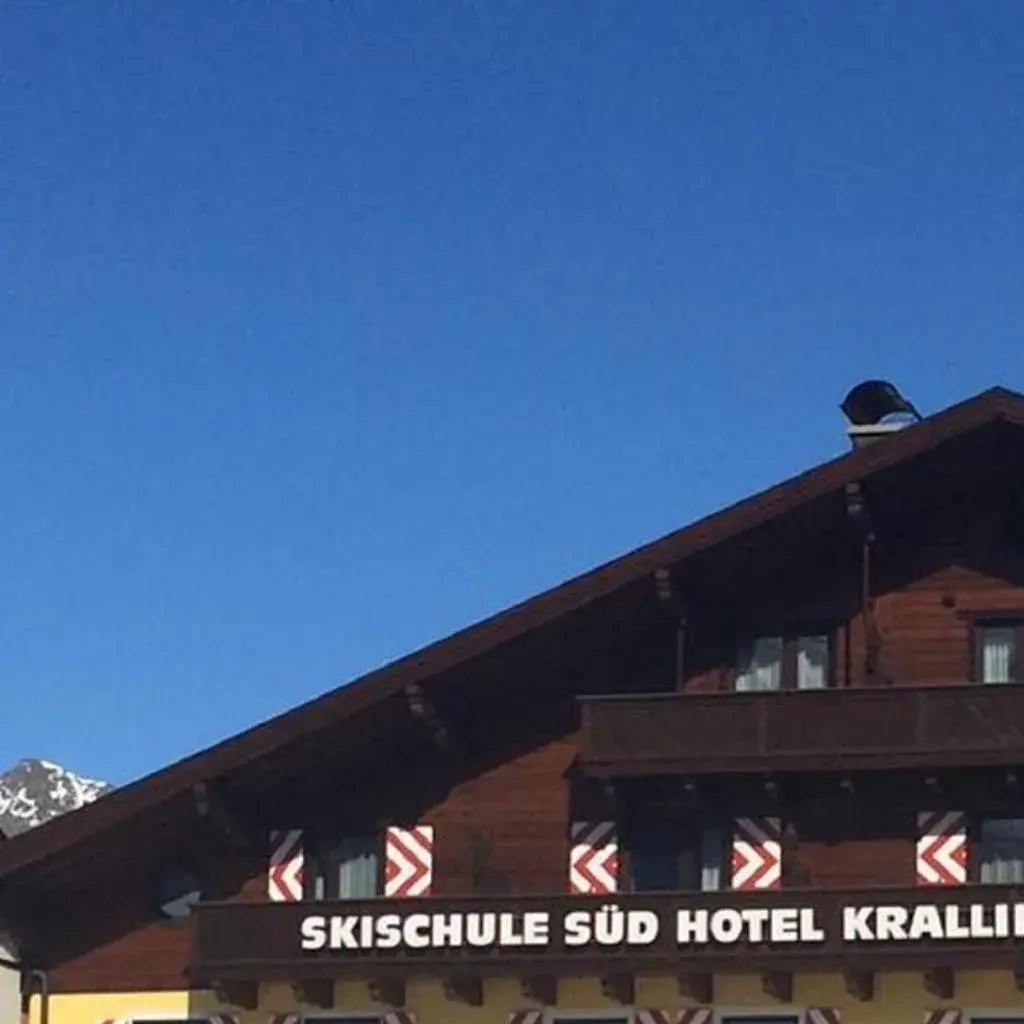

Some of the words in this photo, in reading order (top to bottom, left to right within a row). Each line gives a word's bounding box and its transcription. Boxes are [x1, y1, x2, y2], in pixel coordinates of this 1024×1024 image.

[301, 914, 549, 949] SKISCHULE
[564, 905, 659, 945] SÜD
[677, 909, 824, 942] HOTEL
